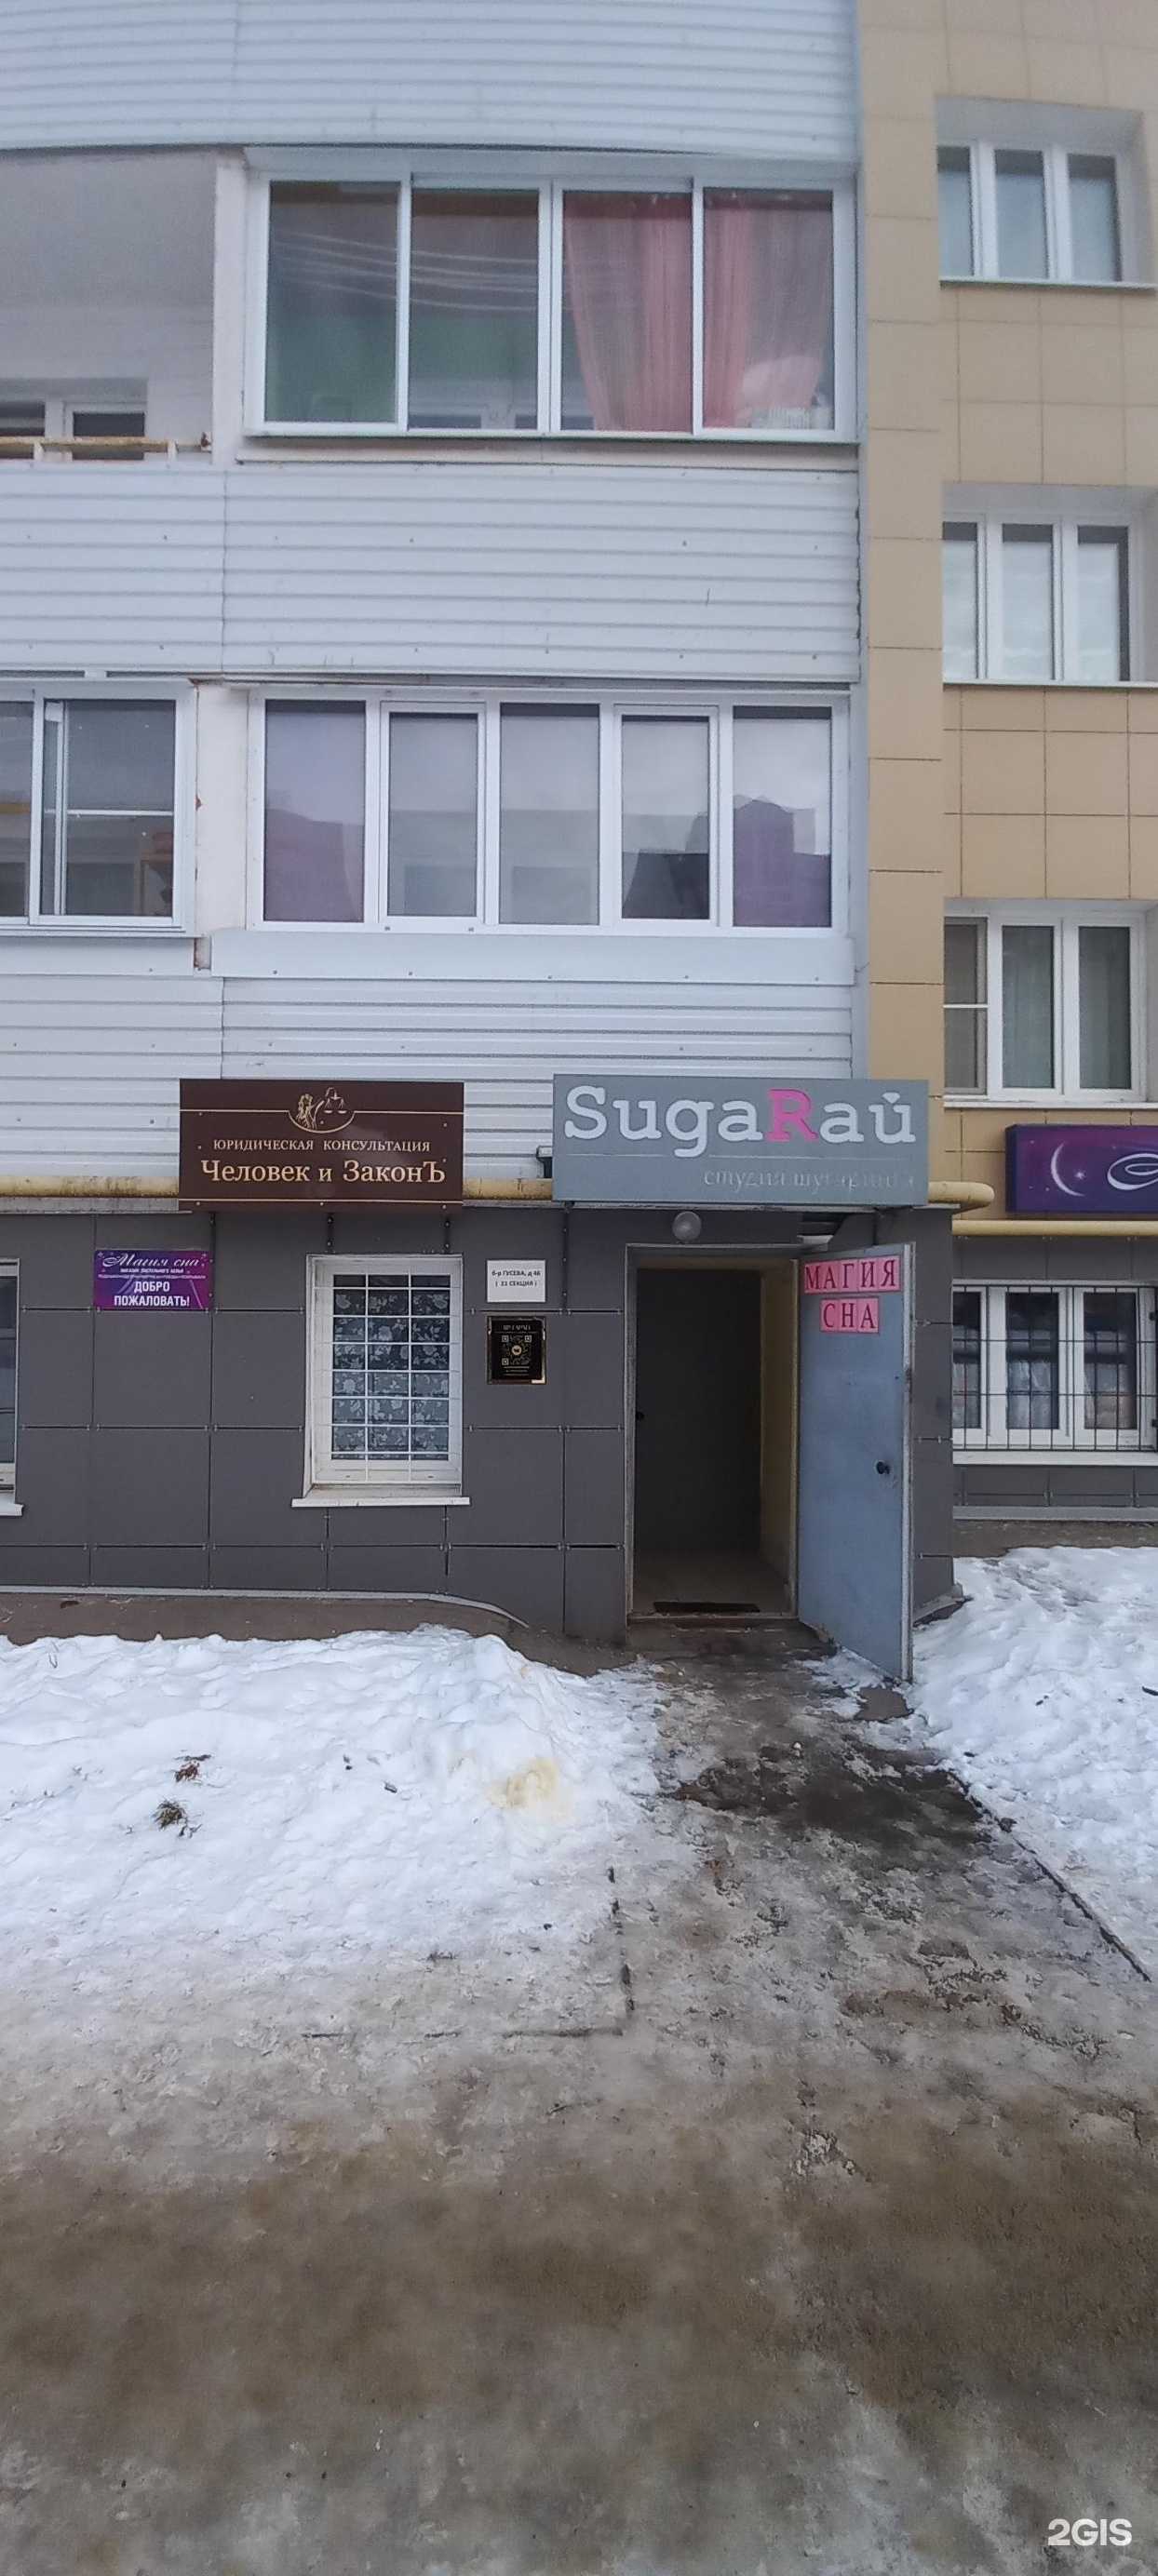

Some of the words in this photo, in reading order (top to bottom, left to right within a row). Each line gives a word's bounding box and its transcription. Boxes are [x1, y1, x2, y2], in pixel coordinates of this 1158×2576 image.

[213, 1139, 314, 1152] ЮРИДИЧЕСКАЯ
[323, 1140, 431, 1153] КОНСУЛЬТАЦИЯ
[201, 1160, 311, 1183] Человек
[318, 1168, 332, 1182] и
[343, 1160, 446, 1184] ЗаконЪ
[102, 1253, 168, 1268] Магия
[173, 1257, 200, 1267] сна
[805, 1259, 895, 1290] МАГИЯ
[134, 1281, 170, 1294] ДОБРО
[114, 1295, 190, 1307] ПОЖАЛОВАТЬ!
[823, 1303, 876, 1329] СНА
